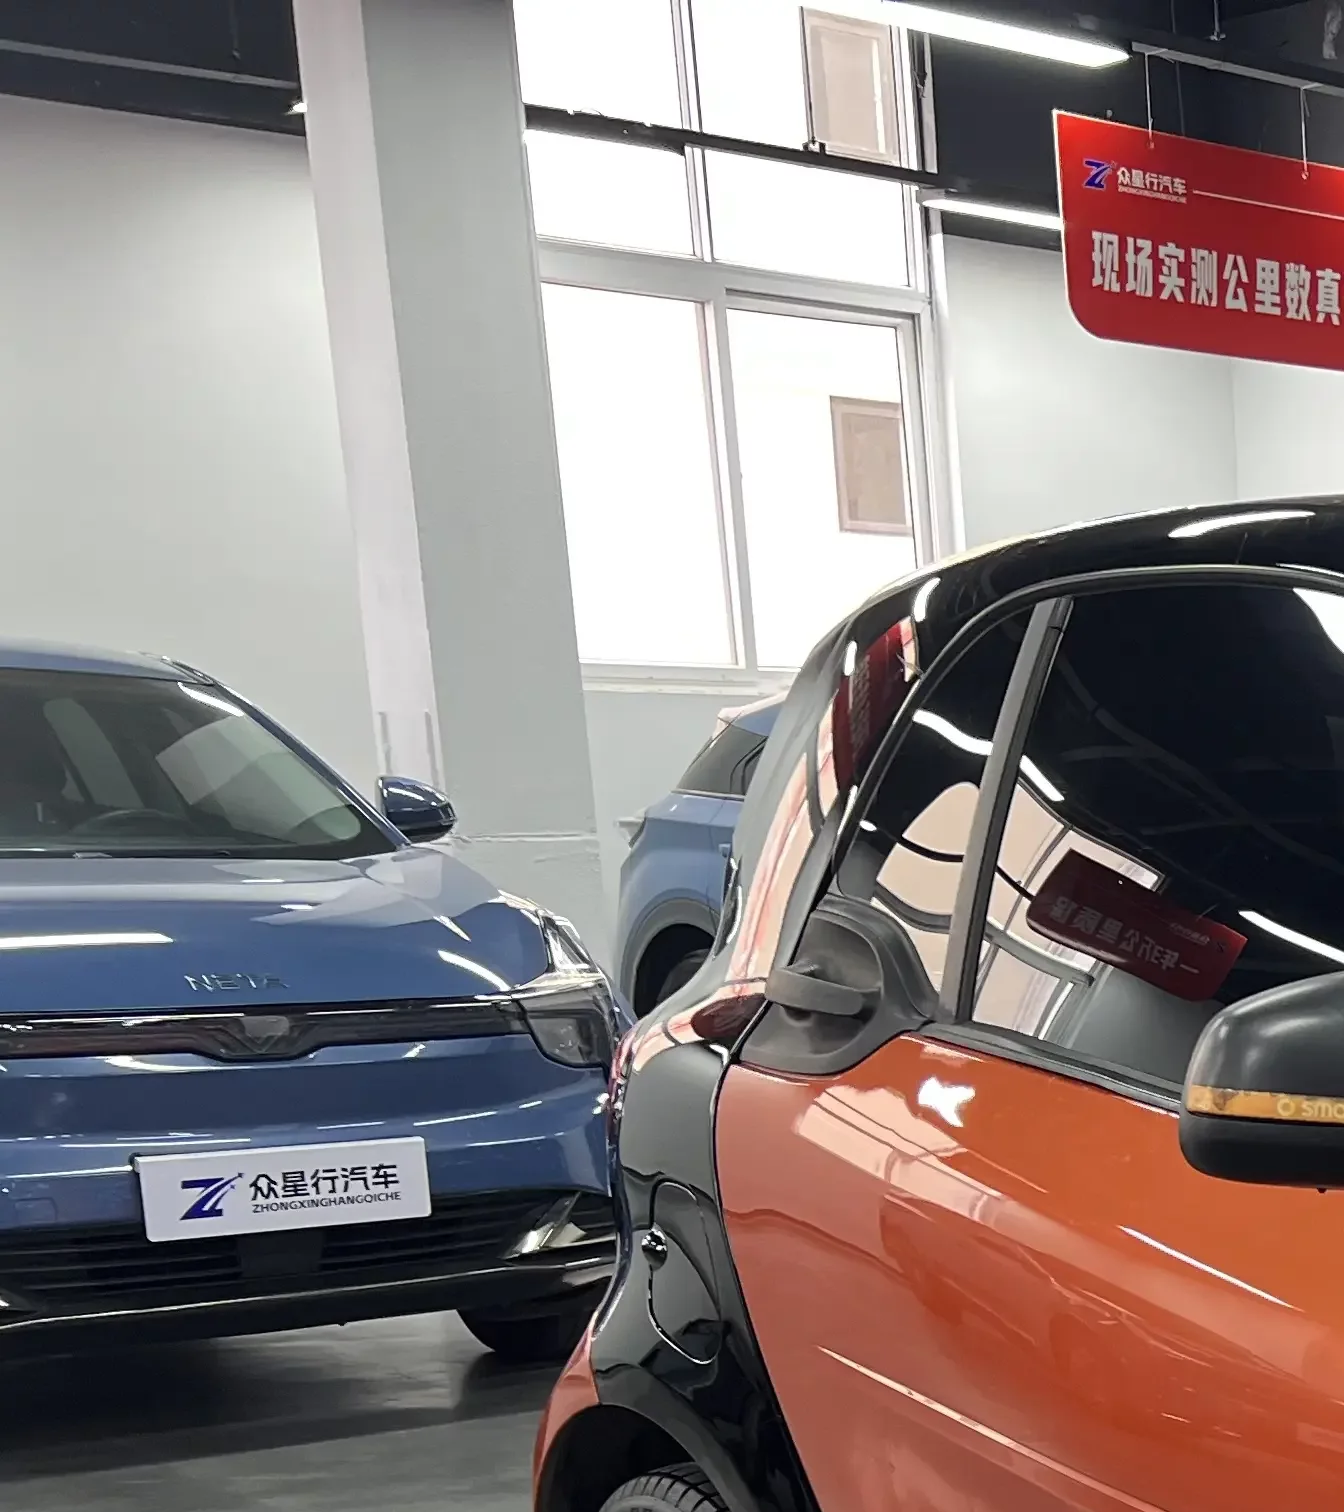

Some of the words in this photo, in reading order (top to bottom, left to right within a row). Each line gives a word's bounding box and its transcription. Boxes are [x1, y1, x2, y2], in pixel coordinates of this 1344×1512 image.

[1117, 166, 1188, 196] 众星行汽车
[249, 1163, 400, 1201] 众星行汽车
[252, 1191, 402, 1213] ZHONGXINGHANGQICHE
